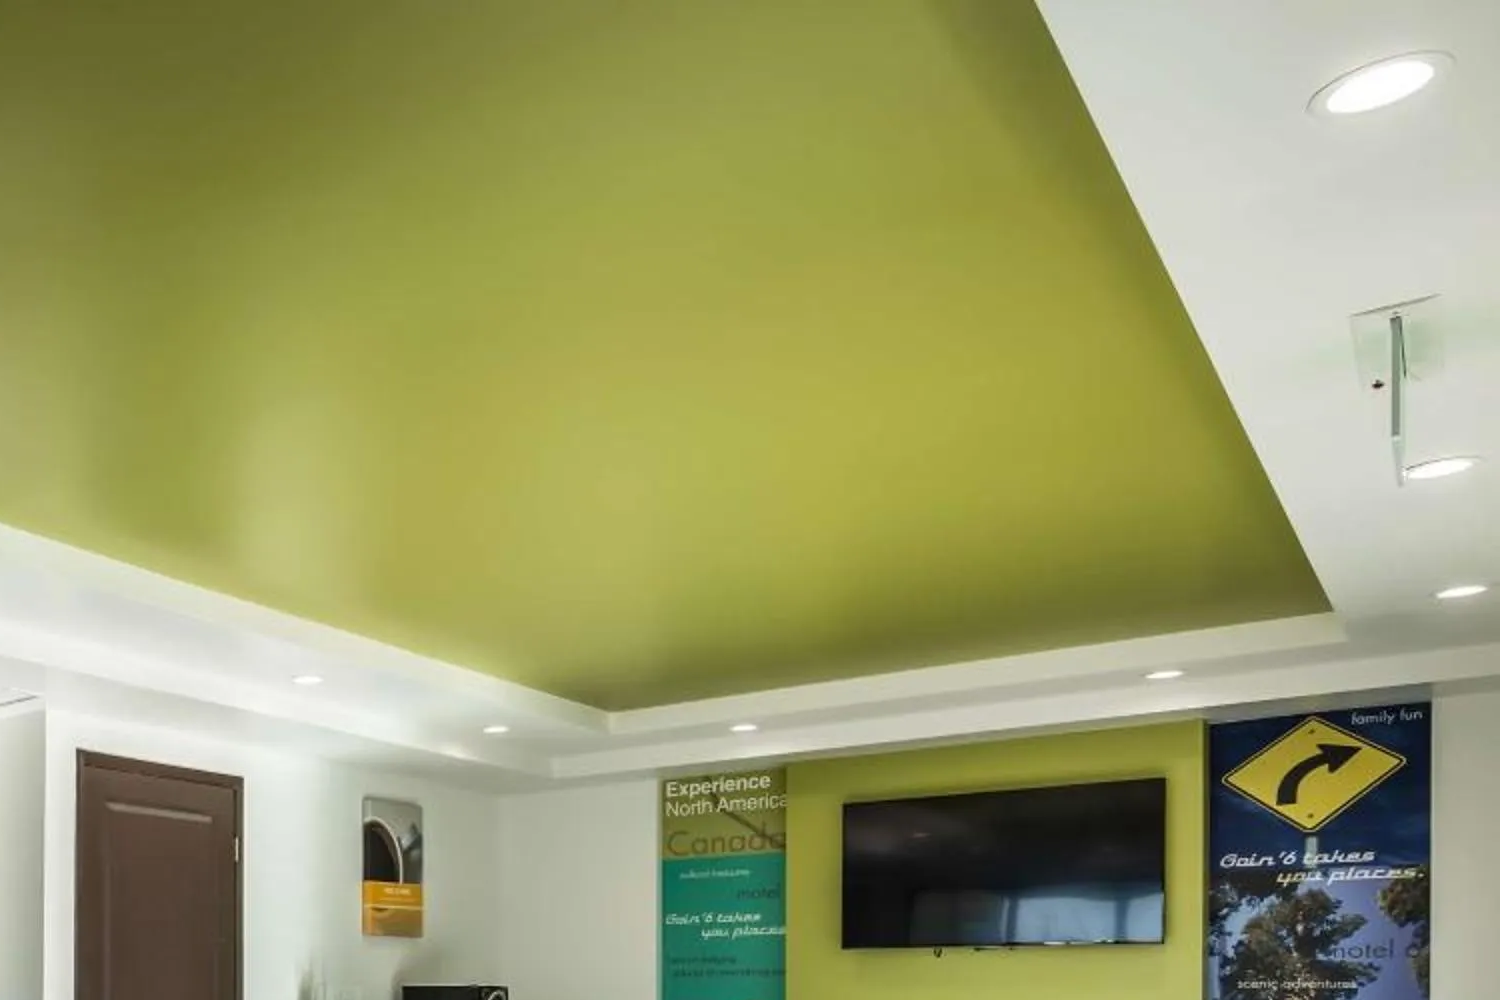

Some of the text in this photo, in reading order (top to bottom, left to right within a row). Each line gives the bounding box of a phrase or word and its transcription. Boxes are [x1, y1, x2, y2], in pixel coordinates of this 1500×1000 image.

[1351, 708, 1423, 725] family fun
[666, 775, 771, 800] Experience
[666, 798, 713, 816] North
[1303, 850, 1376, 865] takes
[1276, 869, 1325, 887] you
